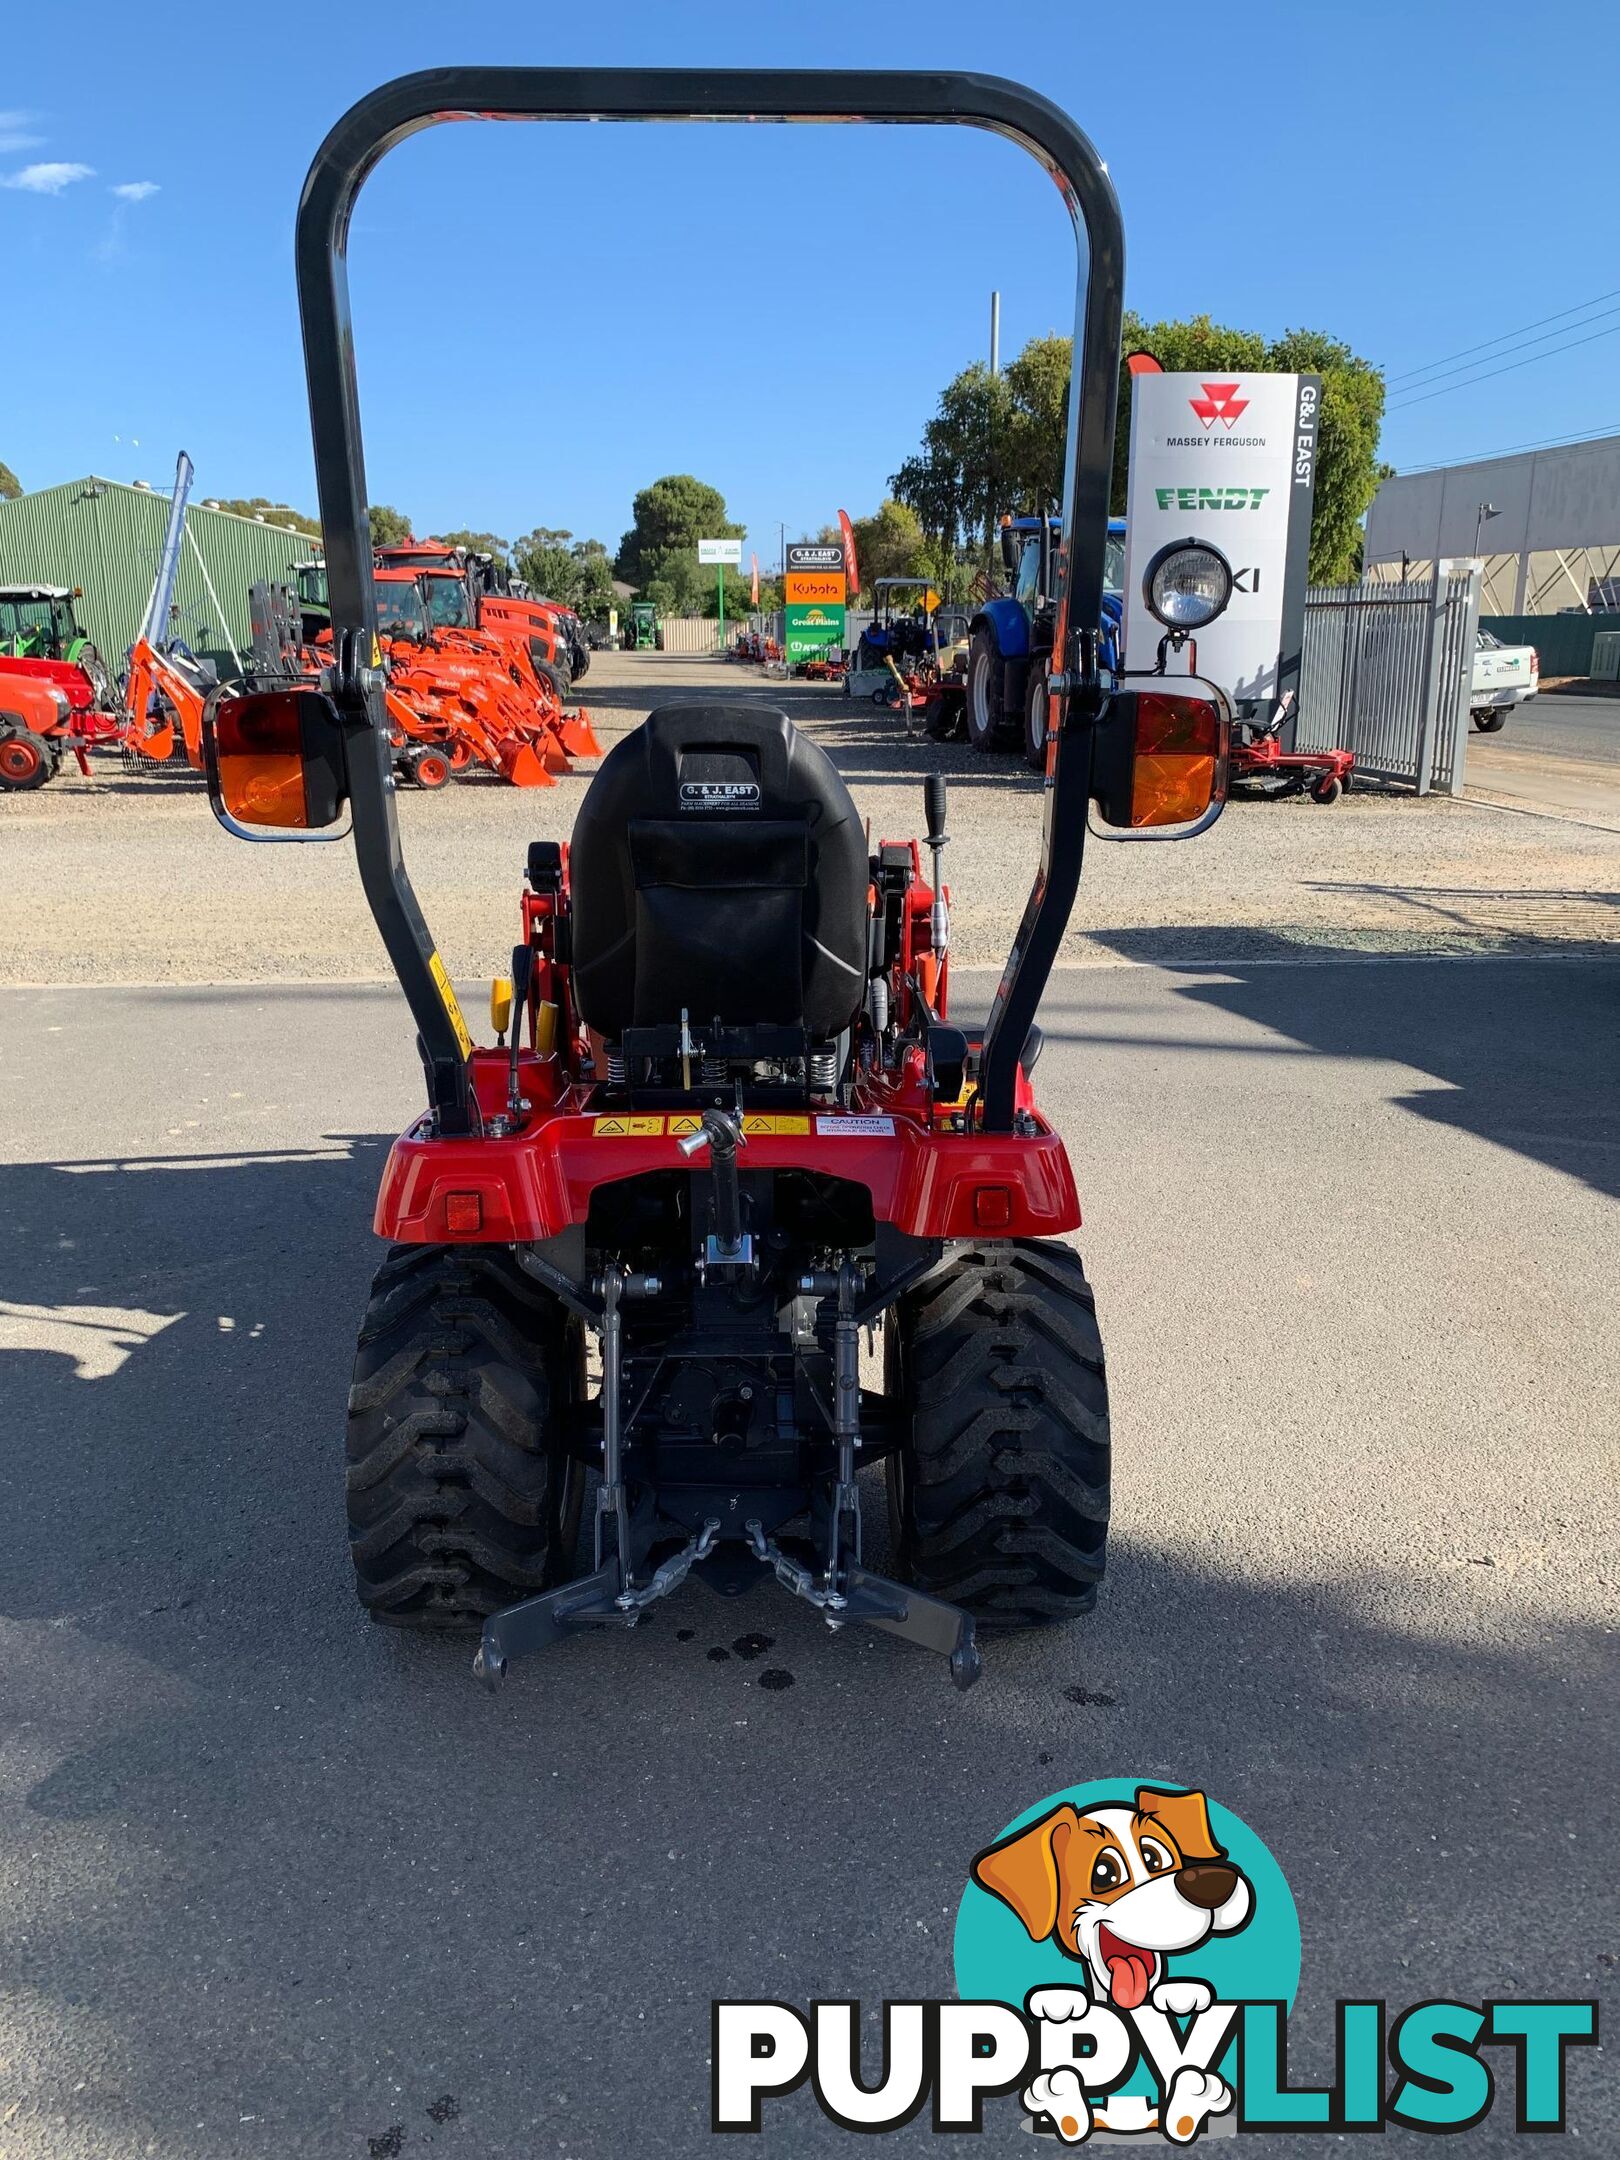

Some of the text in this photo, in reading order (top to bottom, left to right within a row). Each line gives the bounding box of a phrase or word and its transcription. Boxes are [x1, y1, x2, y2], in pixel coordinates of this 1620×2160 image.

[1166, 437, 1266, 447] MASSEY FERGUSON
[1294, 386, 1317, 488] G&J EAST
[1155, 488, 1271, 511] FENDT
[793, 583, 839, 594] Kubota
[792, 618, 840, 626] Great Plains
[686, 786, 753, 795] G. & J. EAST
